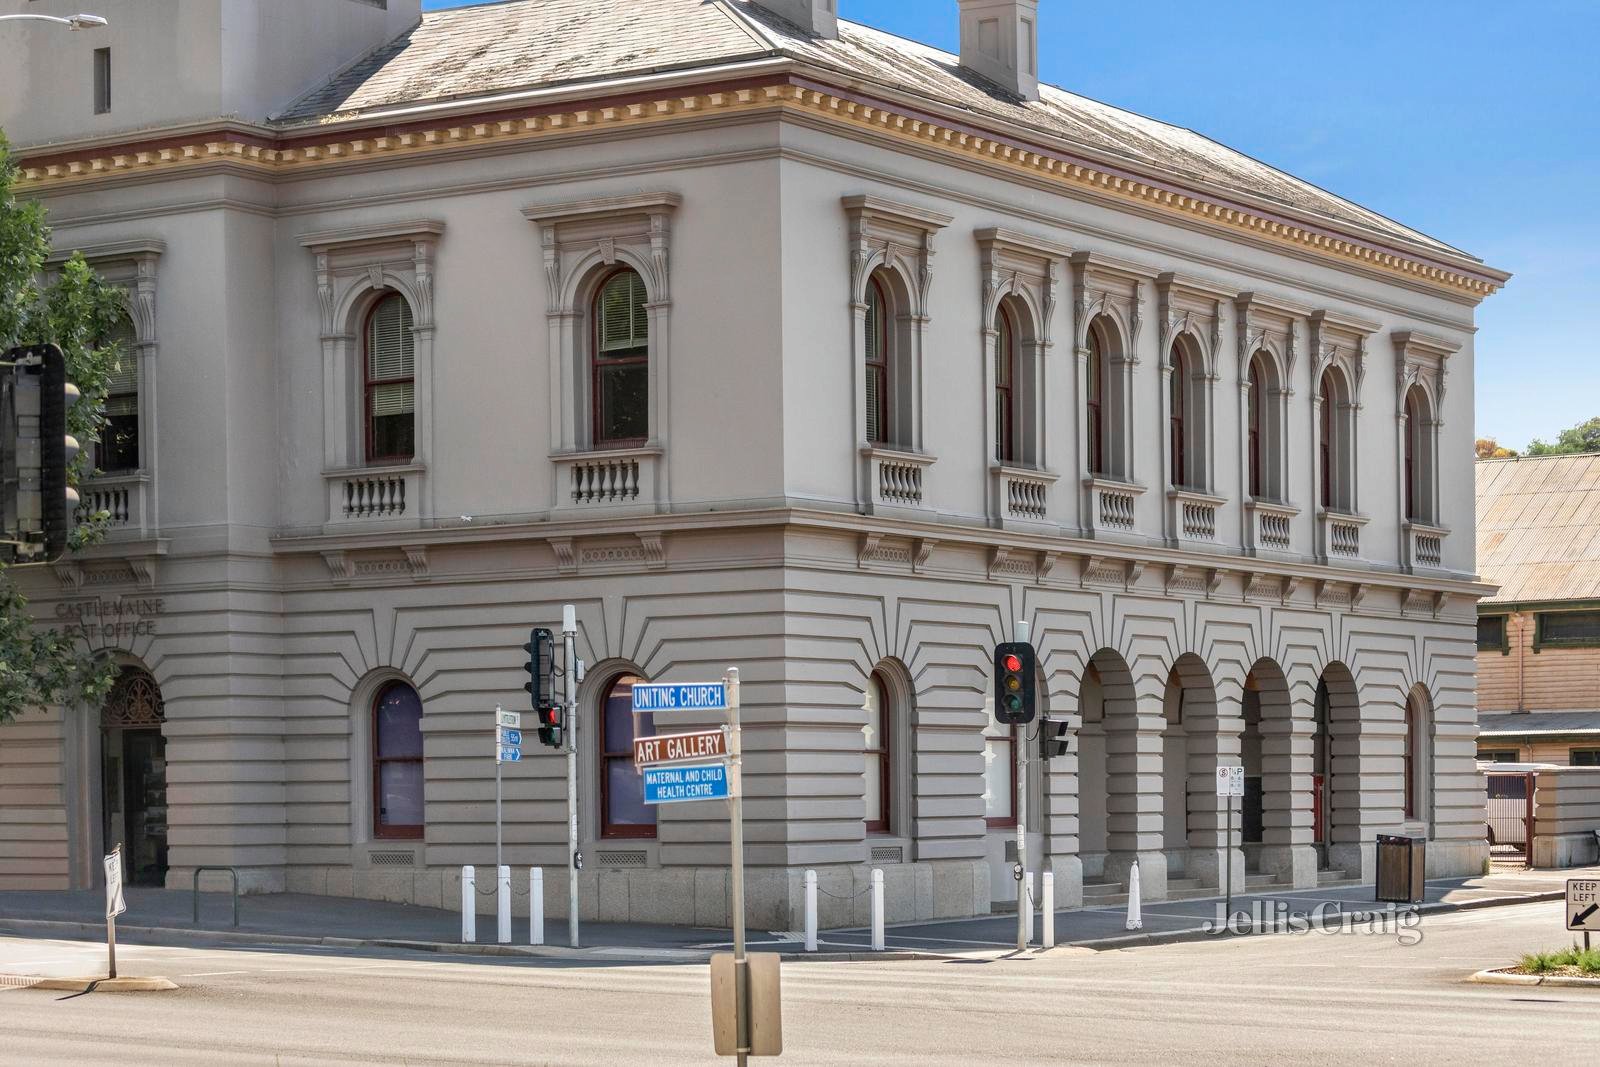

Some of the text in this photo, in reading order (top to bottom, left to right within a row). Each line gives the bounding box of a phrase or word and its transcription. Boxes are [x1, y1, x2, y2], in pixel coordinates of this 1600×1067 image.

[56, 599, 163, 618] CASTLEMAINE
[64, 621, 155, 639] POST OFFICE
[634, 687, 721, 707] UNITING CHURCH
[637, 735, 720, 761] ART GALLERY
[646, 769, 723, 785] MATERNAL AND CHILD
[657, 783, 713, 798] HEALTH CENTRE
[1573, 883, 1597, 891] KEEP
[1573, 893, 1596, 902] LEFT
